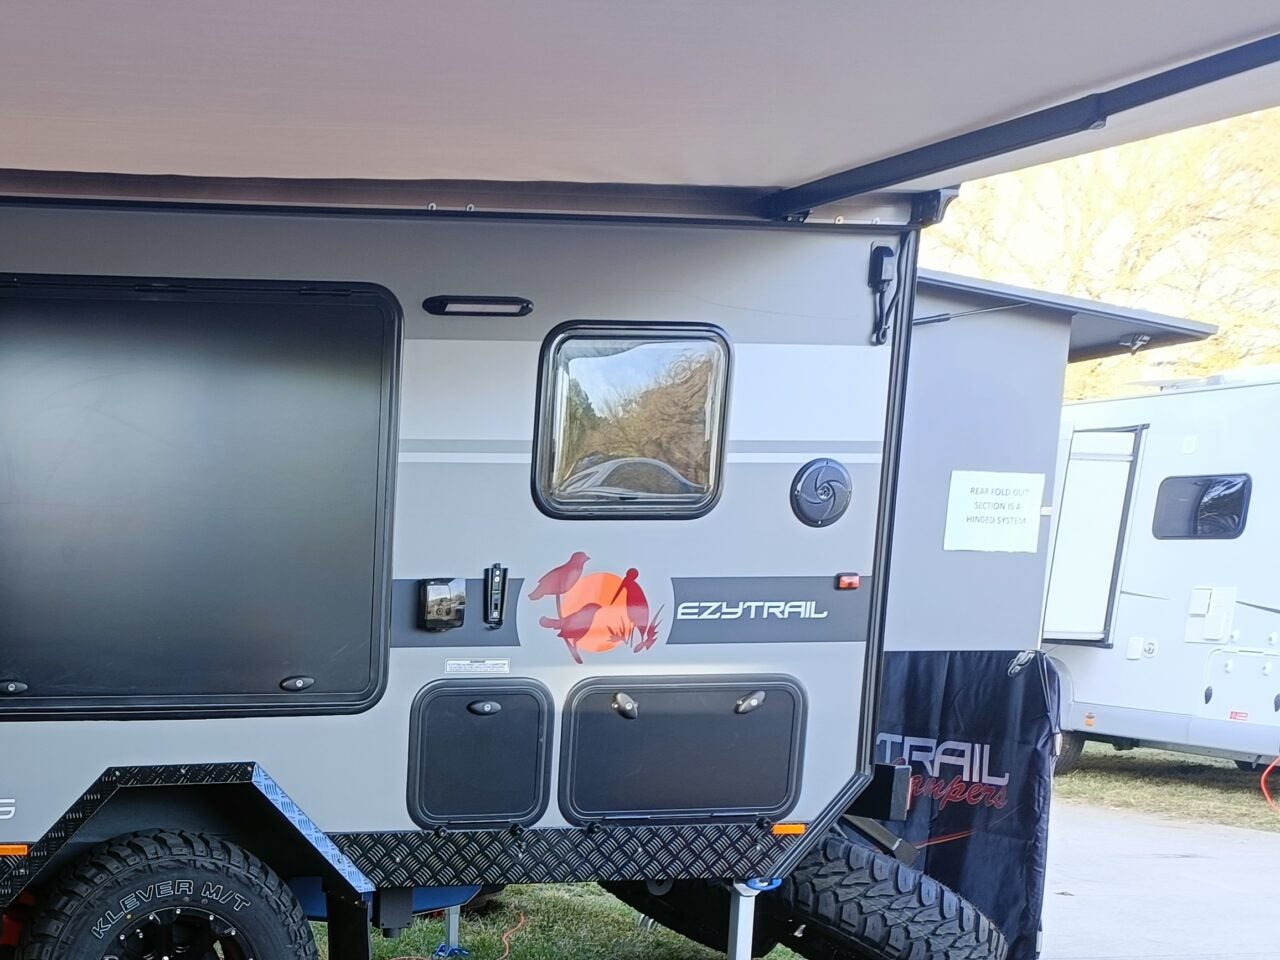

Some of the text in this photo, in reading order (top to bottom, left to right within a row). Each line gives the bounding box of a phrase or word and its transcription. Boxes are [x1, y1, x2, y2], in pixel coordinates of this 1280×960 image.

[970, 487, 1029, 497] REAR FOLD OUT
[974, 501, 1006, 511] SECTION
[1008, 501, 1015, 511] IS
[966, 515, 1027, 526] HINGED SYSTEM
[676, 601, 829, 620] EZYTRAIL
[898, 767, 1009, 811] ampers
[90, 879, 252, 939] KLEVER M/T
